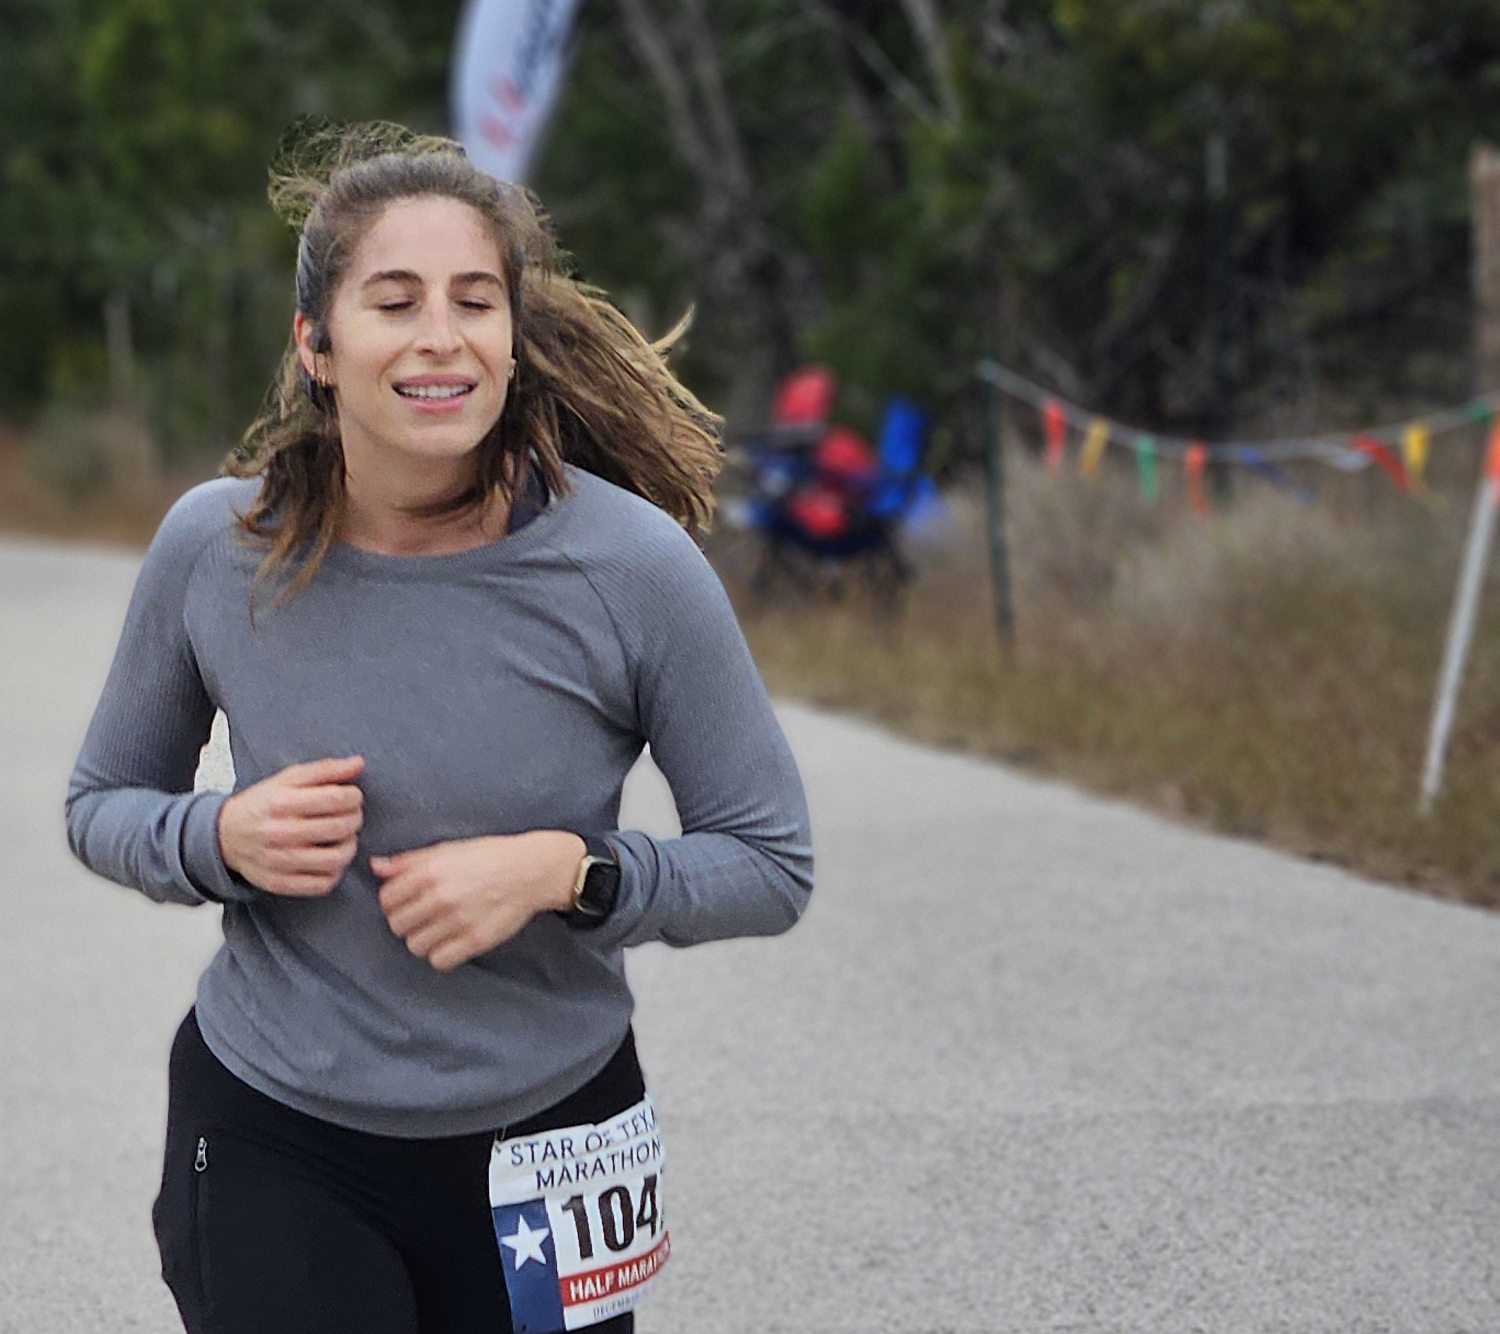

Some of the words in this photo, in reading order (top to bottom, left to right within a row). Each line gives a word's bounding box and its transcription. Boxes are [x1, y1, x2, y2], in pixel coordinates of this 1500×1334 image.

[510, 1136, 575, 1167] STAR
[536, 1134, 661, 1191] MARATHON
[569, 1270, 615, 1302] HALF
